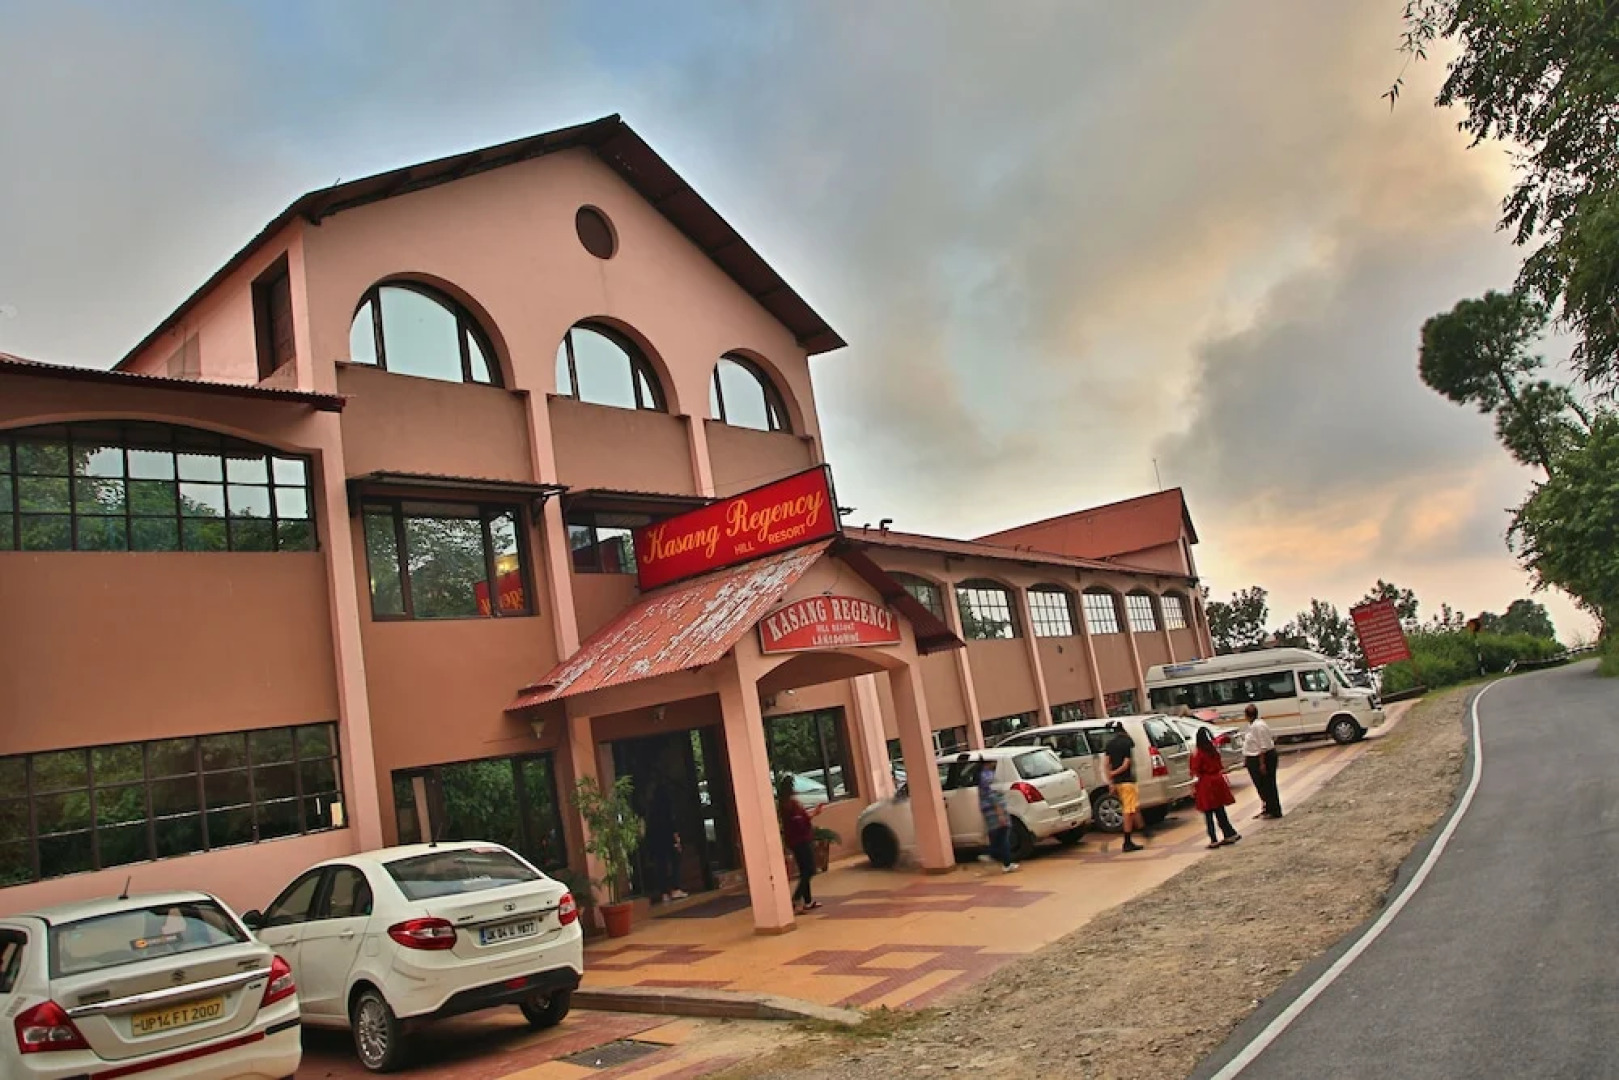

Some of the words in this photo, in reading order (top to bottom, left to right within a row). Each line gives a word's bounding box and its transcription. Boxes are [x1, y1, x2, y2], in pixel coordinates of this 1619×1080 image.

[643, 524, 720, 560] Kasang
[726, 490, 823, 542] Regency
[734, 541, 755, 556] HILL
[768, 523, 807, 545] RESORT
[766, 599, 827, 642] KASANG
[831, 599, 893, 632] REGENCY
[191, 1003, 221, 1020] 2007
